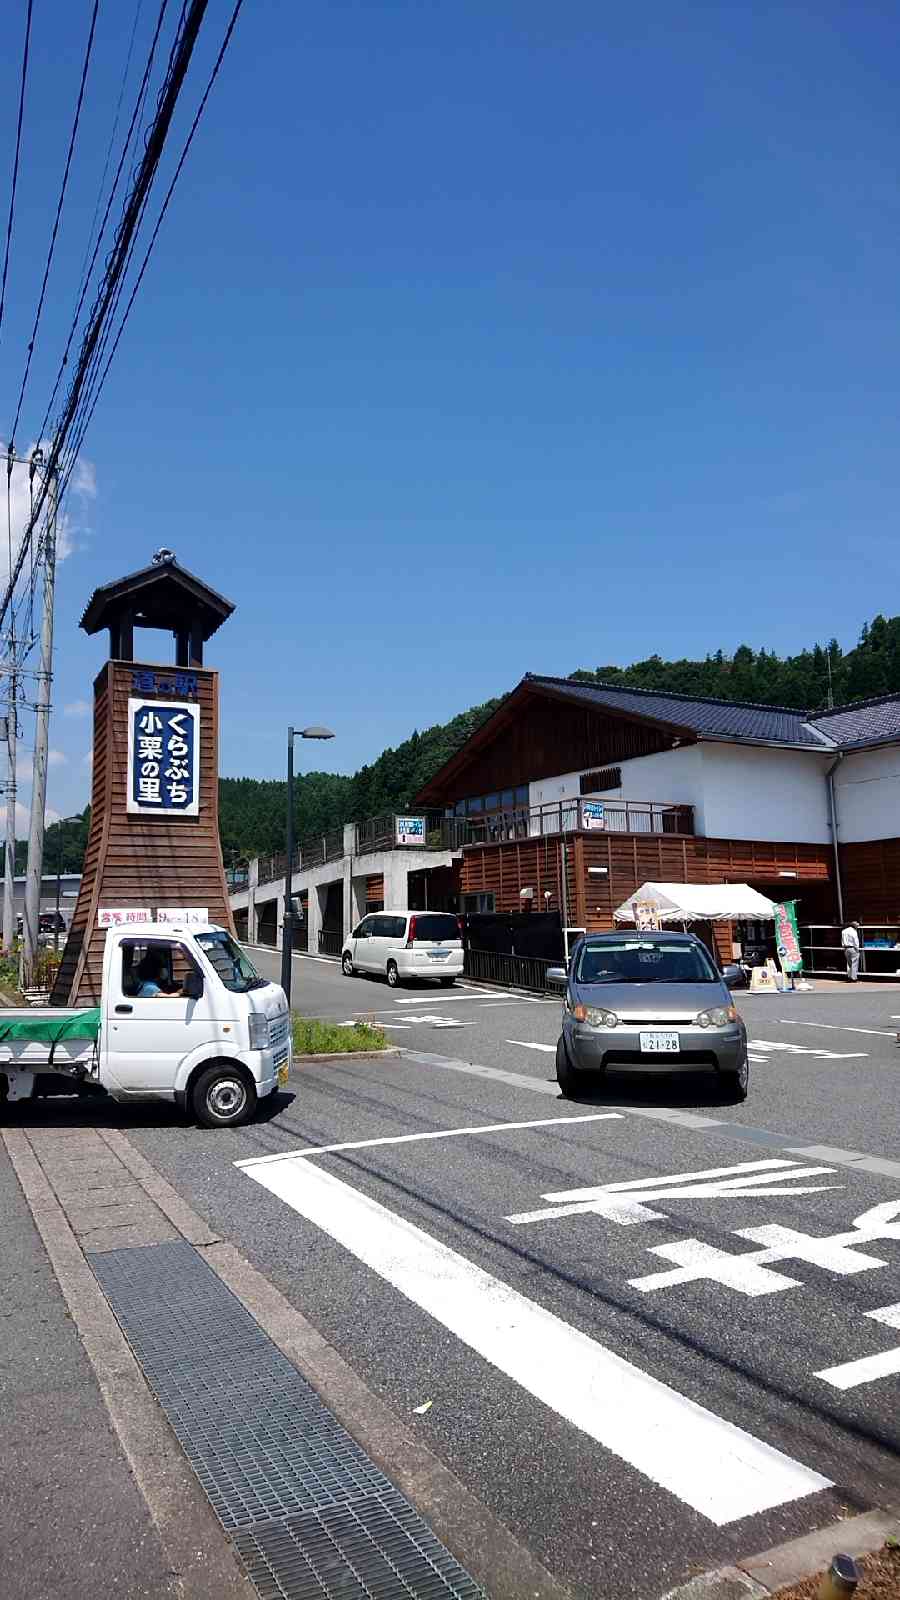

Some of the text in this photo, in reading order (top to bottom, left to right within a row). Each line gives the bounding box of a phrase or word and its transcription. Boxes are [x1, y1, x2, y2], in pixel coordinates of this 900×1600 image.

[137, 711, 163, 803] 小栗の里
[164, 713, 190, 803] くらぶち
